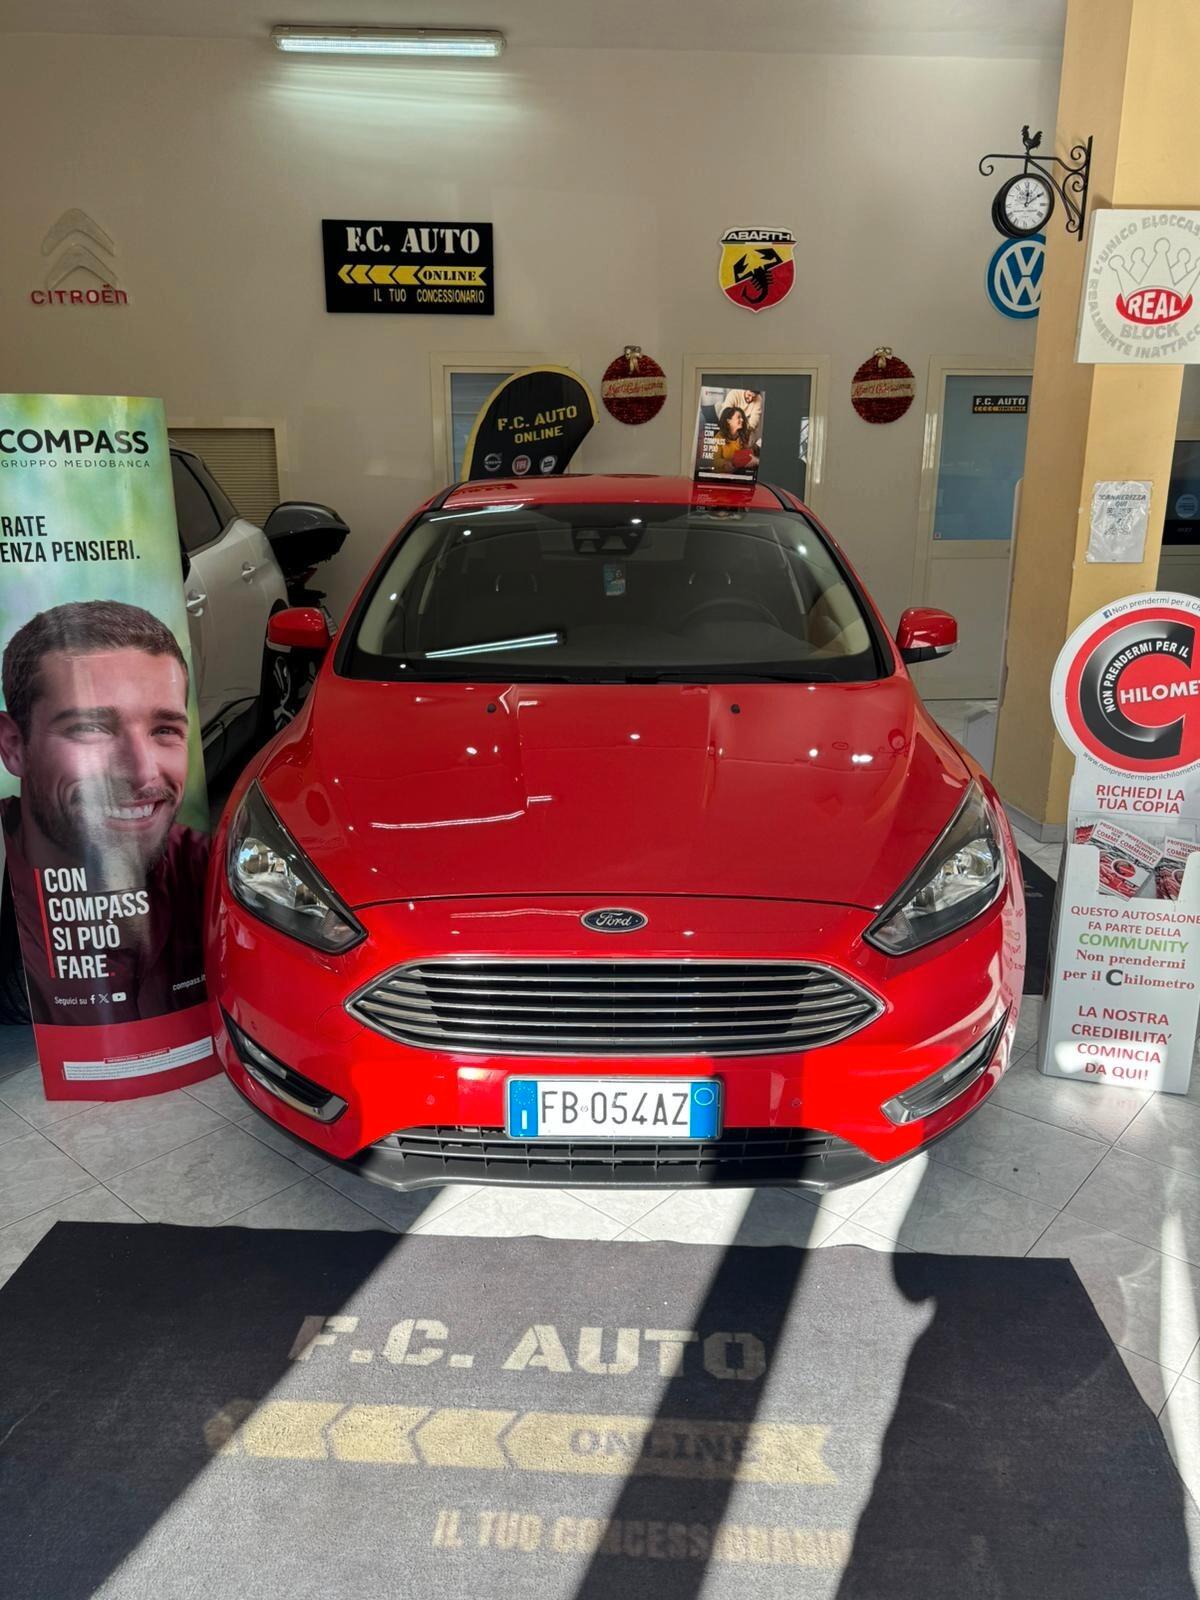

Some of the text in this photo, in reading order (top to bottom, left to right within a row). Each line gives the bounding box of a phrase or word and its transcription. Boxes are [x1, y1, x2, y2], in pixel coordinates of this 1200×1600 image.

[346, 226, 480, 254] F.C. AUTO
[726, 230, 790, 241] ABARTH
[423, 270, 476, 282] ONLINE
[373, 288, 485, 304] IL TUO CONCESSIONARIO
[1127, 291, 1181, 320] REAL
[1120, 322, 1180, 340] BLOCK
[975, 397, 1026, 406] F.C. AUTO
[497, 405, 578, 432] F.C. AUTO
[0, 428, 149, 454] COMPASS
[514, 425, 564, 444] ONLINE
[1, 459, 150, 468] GRUPPO MEDIOBANCA
[1, 515, 48, 537] RATE
[52, 539, 141, 563] PENSIERI.
[1112, 603, 1127, 616] Non
[1129, 597, 1170, 610] prendermi
[1171, 598, 1185, 607] per
[1103, 641, 1190, 713] NON PRENDERMI PER IL
[1096, 784, 1185, 801] RICHIEDI LA
[1097, 797, 1180, 814] TUA COPIA
[44, 867, 87, 893] CON
[48, 890, 150, 922] COMPASS
[1071, 905, 1200, 924] QUESTO AUTOSALONE
[595, 912, 632, 926] Ford
[1088, 921, 1181, 937] FA PARTE DELLA
[52, 918, 121, 951] SI PUÒ
[1079, 933, 1189, 953] COMMUNITY
[1076, 949, 1186, 969] Non prendermi
[172, 974, 207, 991] compass.it
[1063, 969, 1195, 990] per il Chilometro
[54, 995, 88, 1006] Seguici su
[1078, 1005, 1169, 1026] LA NOSTRA
[1077, 1043, 1161, 1064] COMINCIA
[1085, 1062, 1149, 1080] DA QUI!
[288, 1314, 767, 1381] F.C. AUTO
[569, 1428, 763, 1463] ONLINE
[432, 1509, 463, 1549] IL
[478, 1510, 544, 1552] TUO
